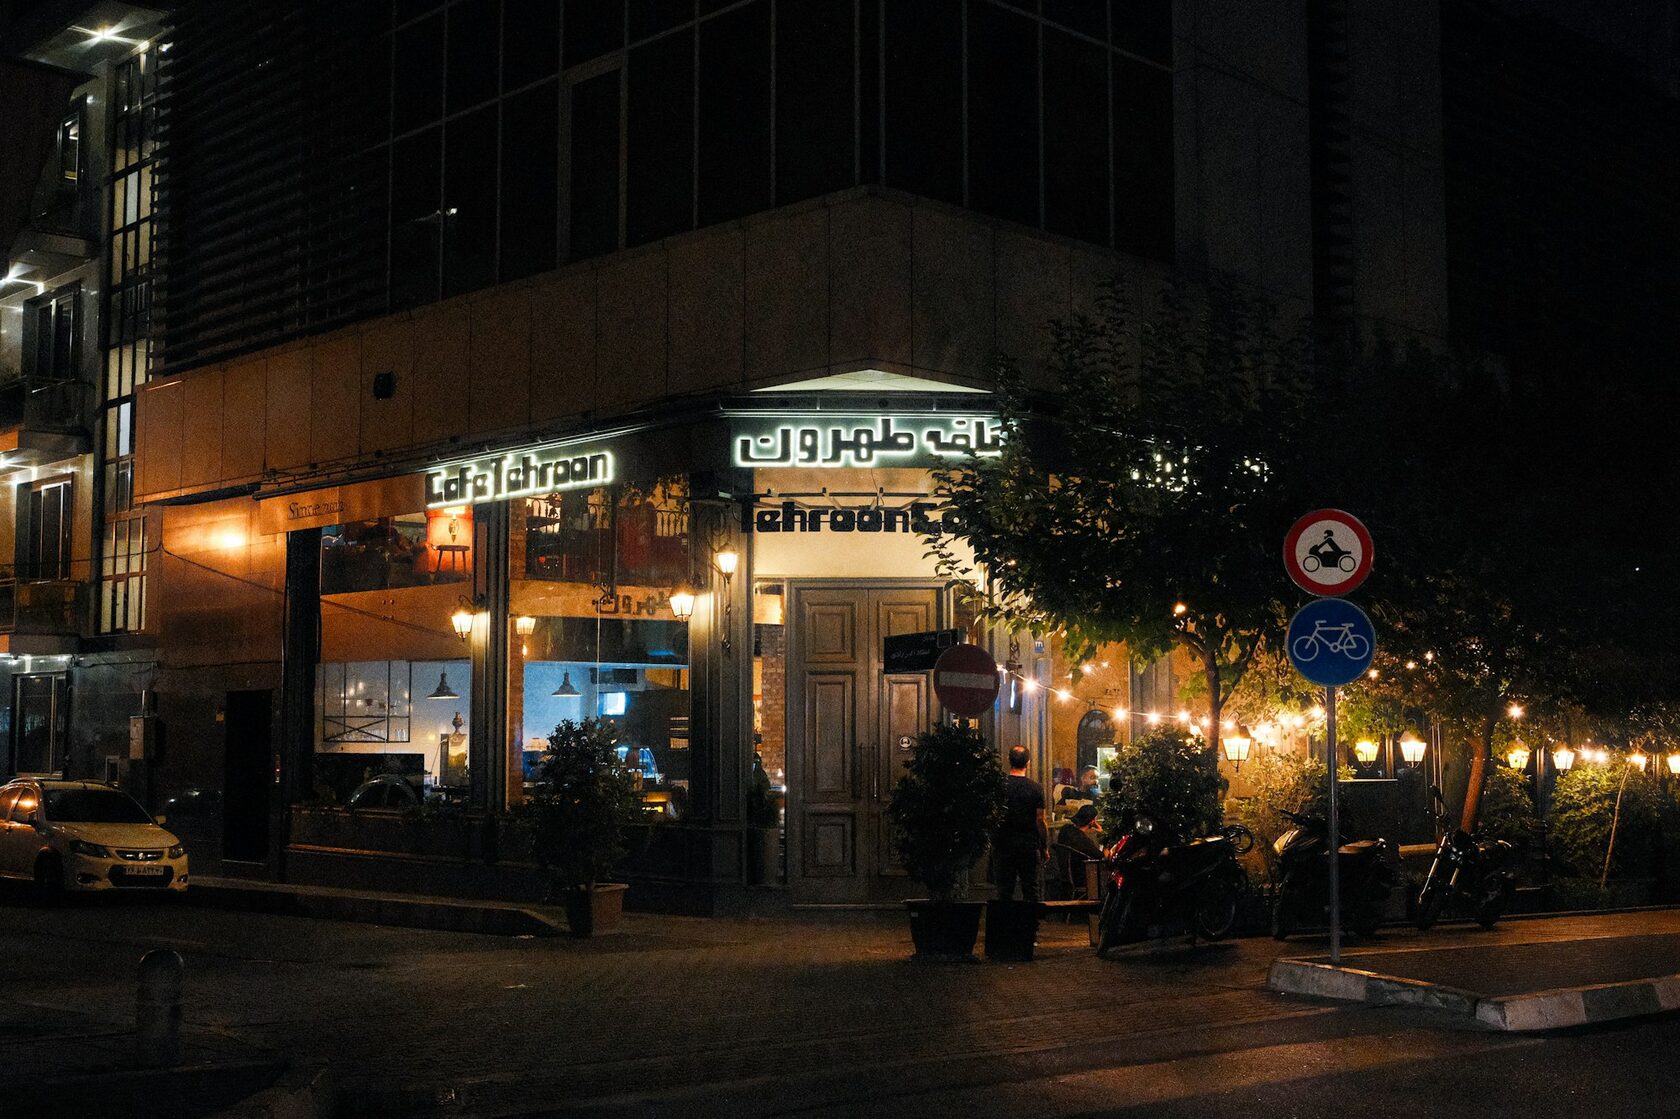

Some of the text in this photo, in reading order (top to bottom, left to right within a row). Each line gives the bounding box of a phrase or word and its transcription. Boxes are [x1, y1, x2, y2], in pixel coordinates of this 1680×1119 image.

[740, 418, 915, 463] طهرون
[424, 453, 608, 505] Cafe Tehroon
[738, 495, 909, 533] Tehroon
